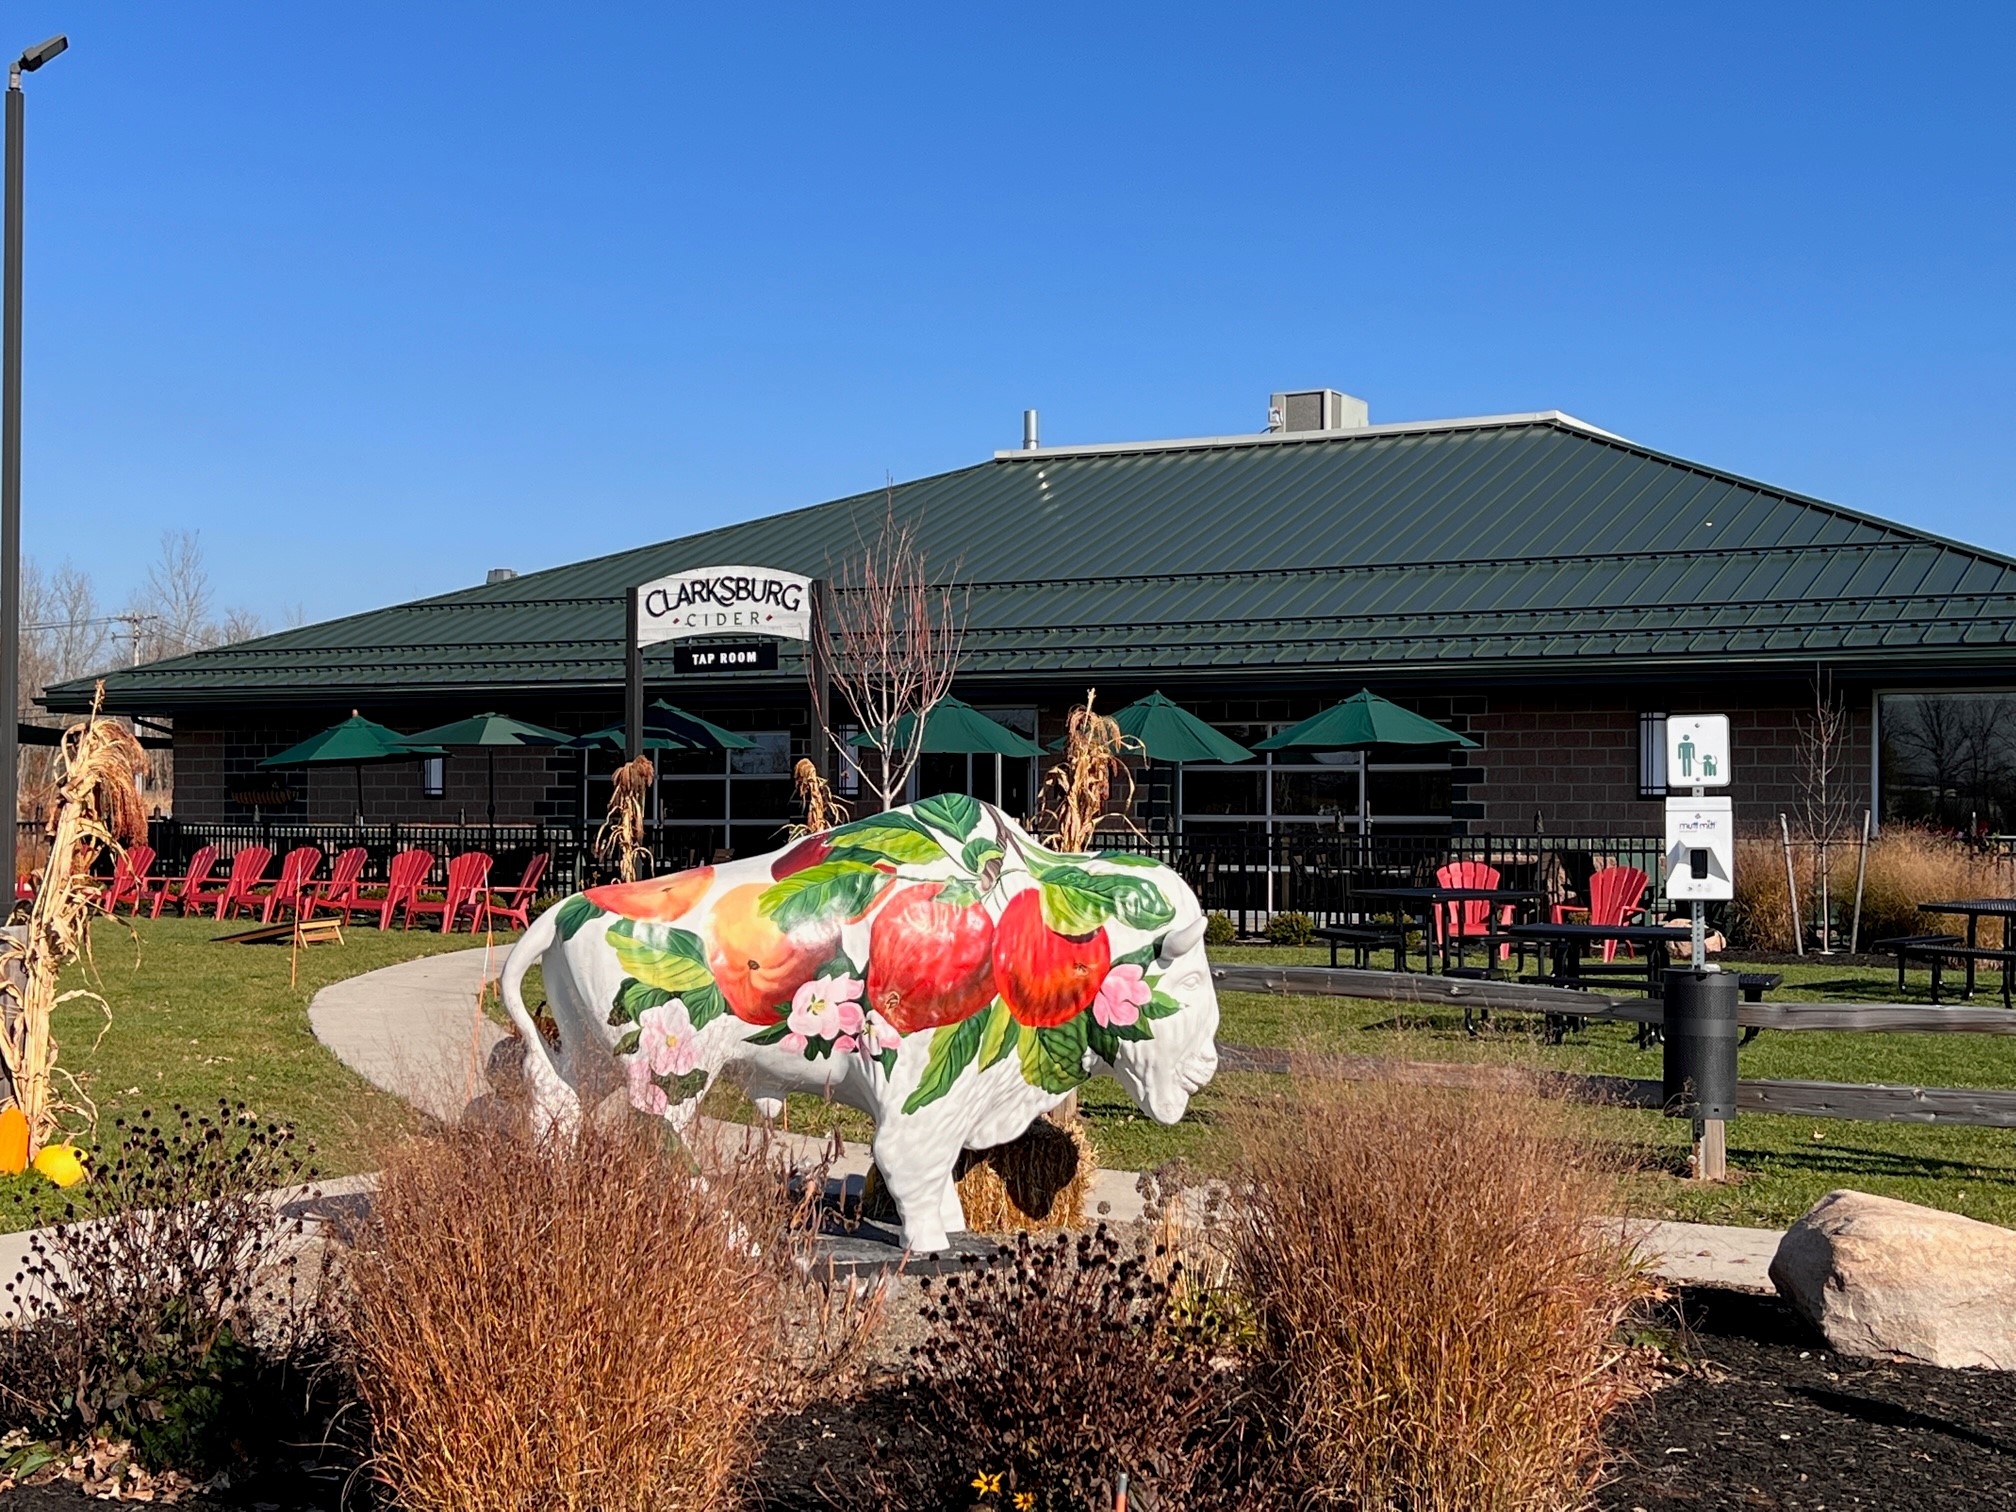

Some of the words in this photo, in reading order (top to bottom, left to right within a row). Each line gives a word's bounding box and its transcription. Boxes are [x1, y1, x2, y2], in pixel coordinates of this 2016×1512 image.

[645, 576, 802, 617] CLARKSBURG
[686, 611, 759, 627] CIDER
[692, 653, 714, 665] TAP
[720, 652, 757, 664] ROOM
